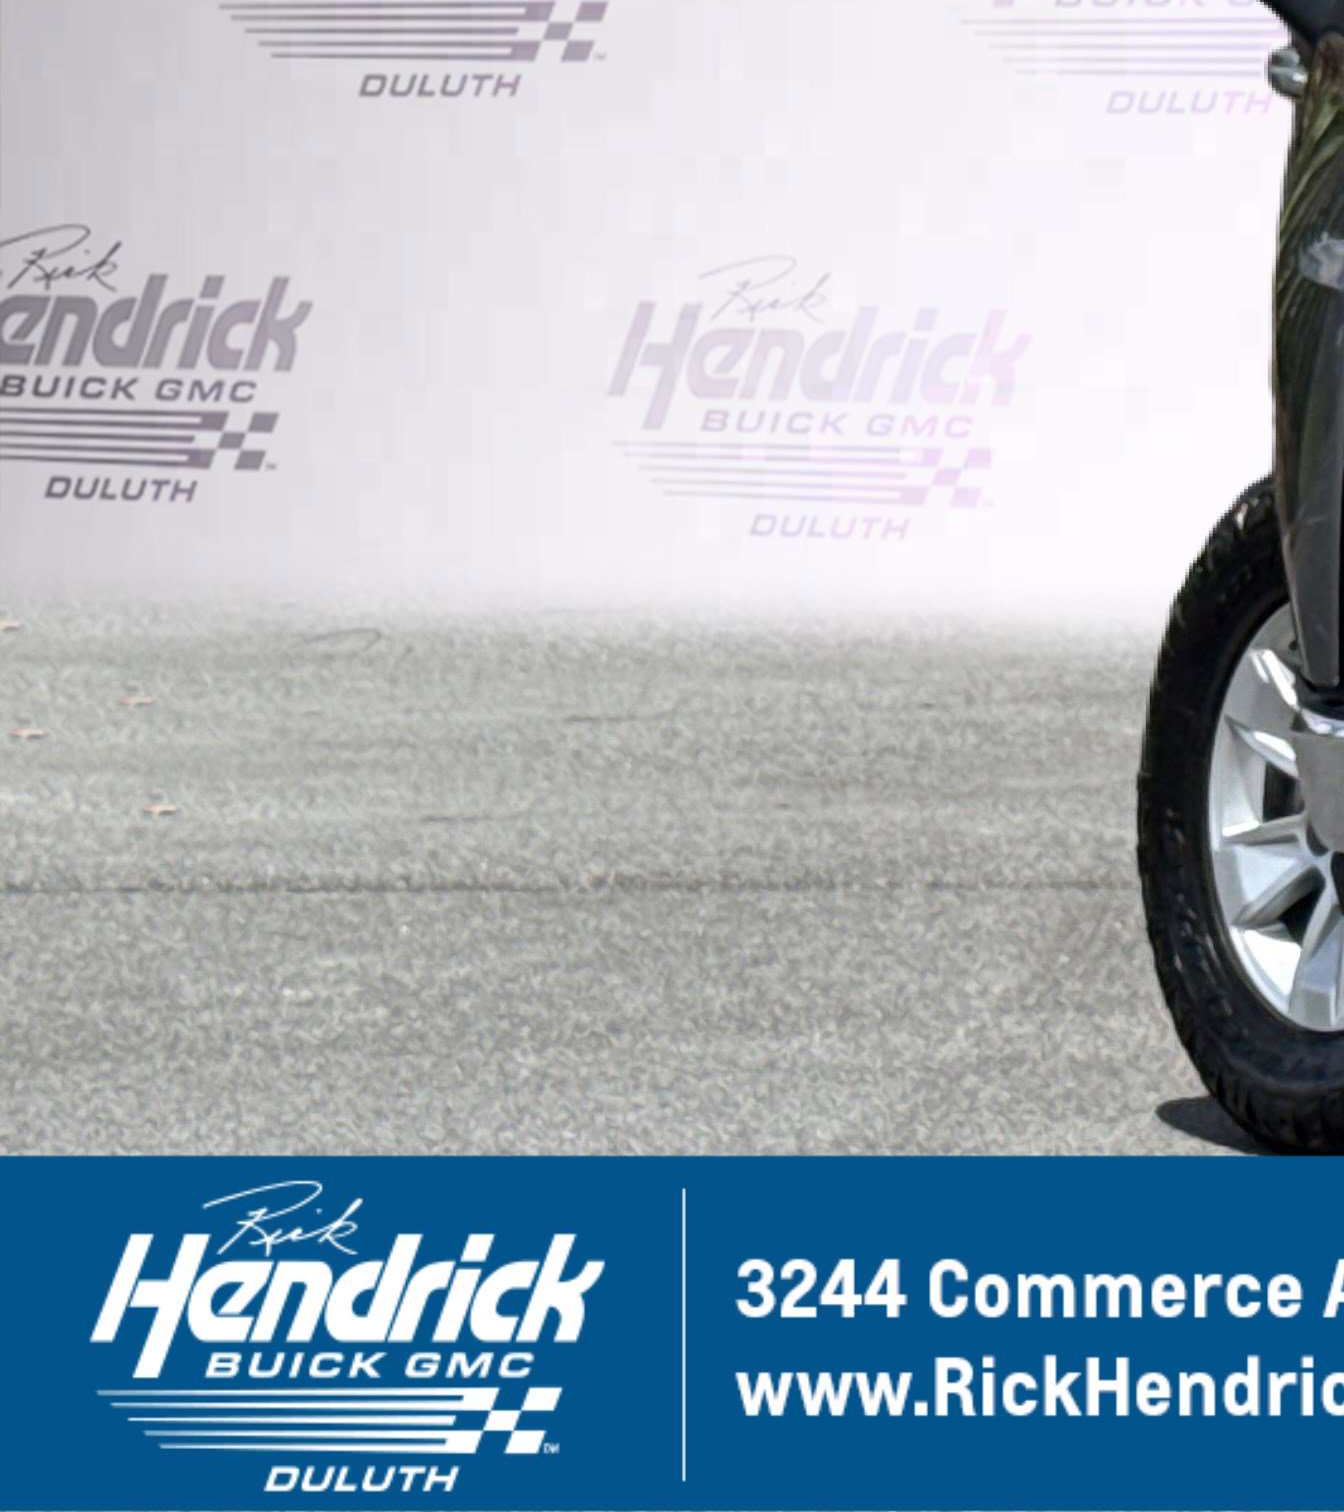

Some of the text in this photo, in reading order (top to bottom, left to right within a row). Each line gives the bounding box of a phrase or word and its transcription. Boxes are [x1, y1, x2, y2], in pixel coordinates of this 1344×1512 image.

[358, 74, 522, 98] DULUTH
[1105, 90, 1274, 115] DULUTH
[0, 274, 313, 372] endrick
[606, 300, 1032, 431] Hendrick
[1, 374, 257, 403] BUICK GMC
[700, 409, 974, 439] BUICK GMC
[45, 475, 198, 503] DULUTH
[748, 512, 911, 541] DULUTH
